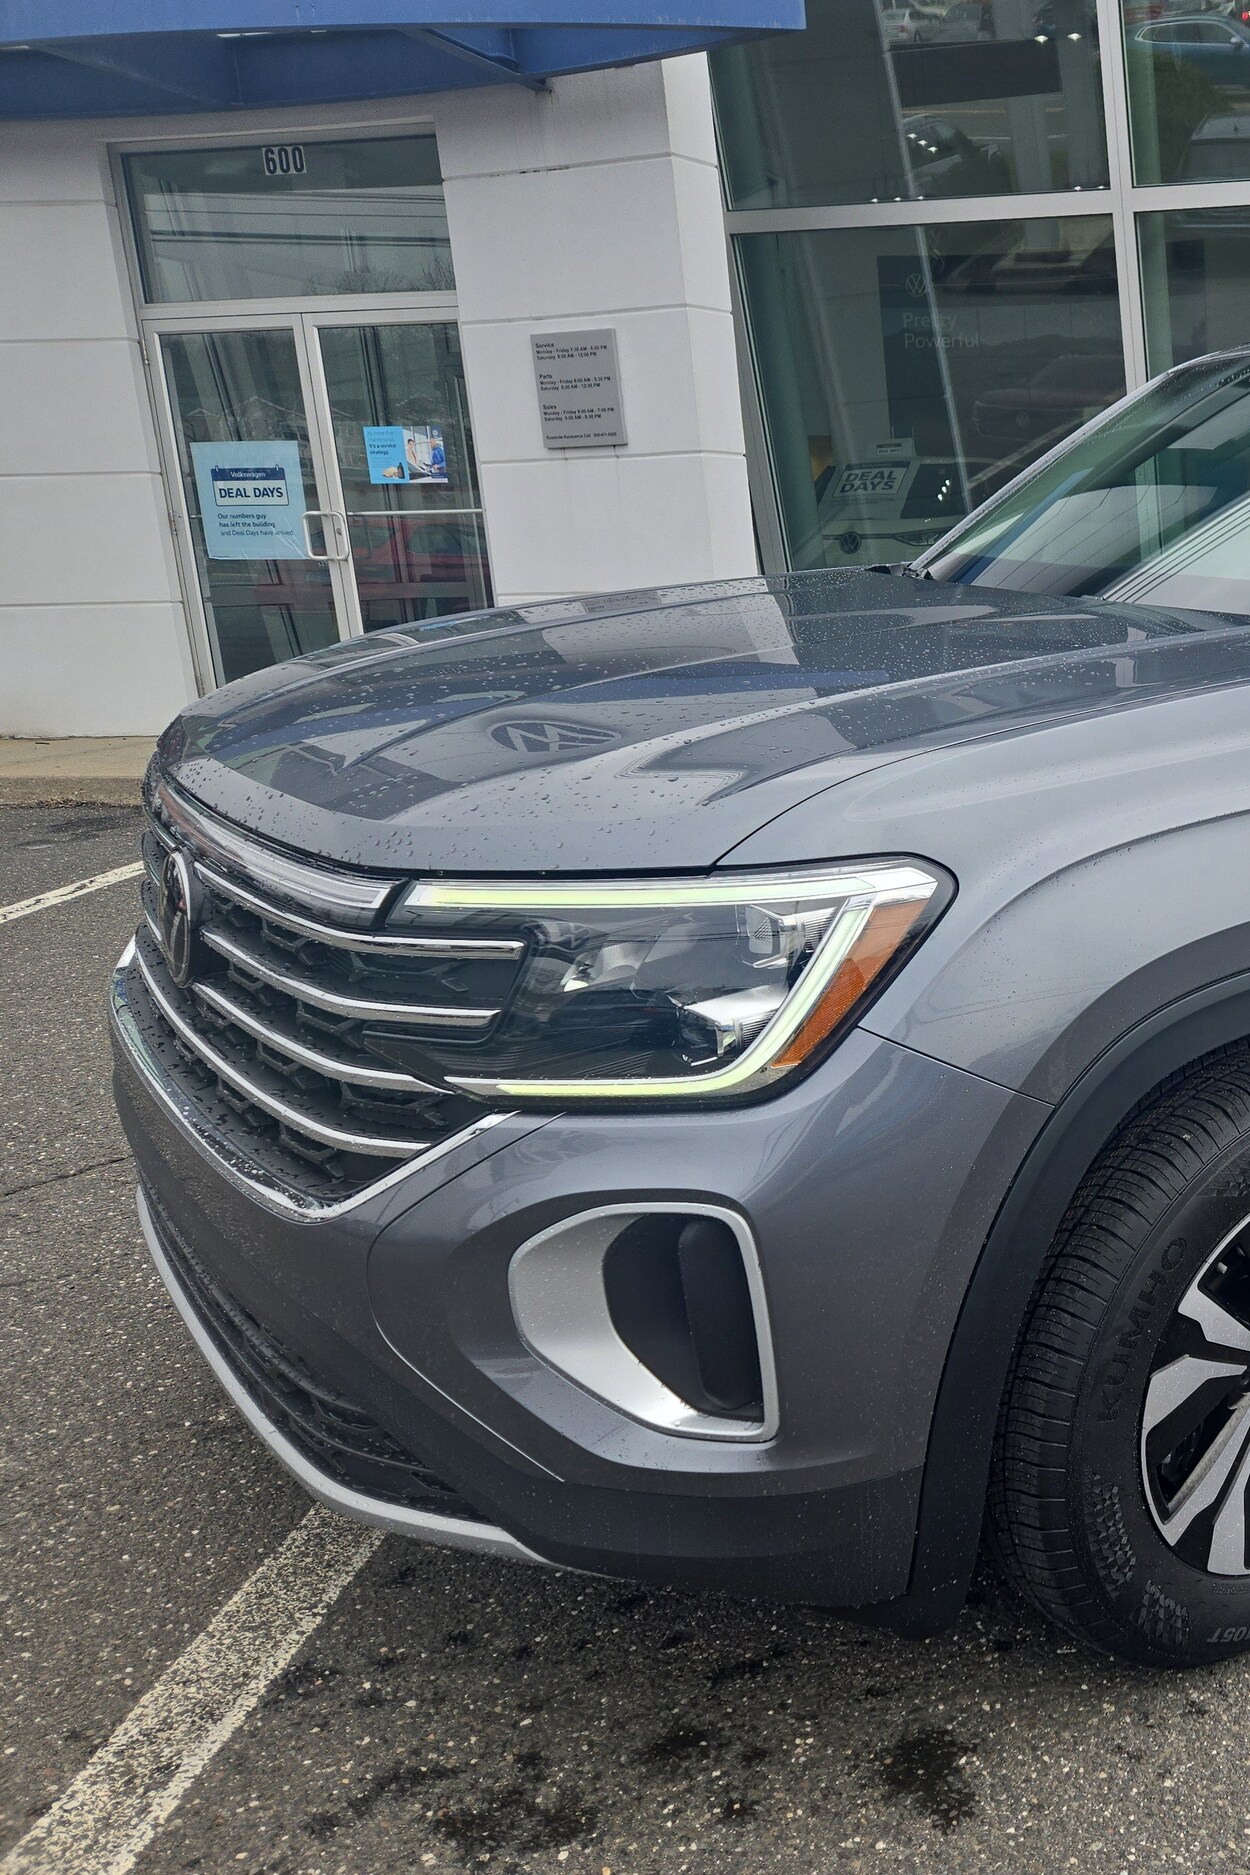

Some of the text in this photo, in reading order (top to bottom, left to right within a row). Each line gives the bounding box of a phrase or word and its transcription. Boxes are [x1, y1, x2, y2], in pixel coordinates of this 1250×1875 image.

[264, 146, 305, 175] 600
[902, 312, 957, 333] Prey
[230, 471, 266, 479] Volkswagen
[845, 470, 898, 483] DEAL
[219, 487, 284, 499] DEAL DAYS
[840, 480, 895, 494] DAYS
[252, 521, 276, 529] building
[1096, 1236, 1188, 1424] KUMHO
